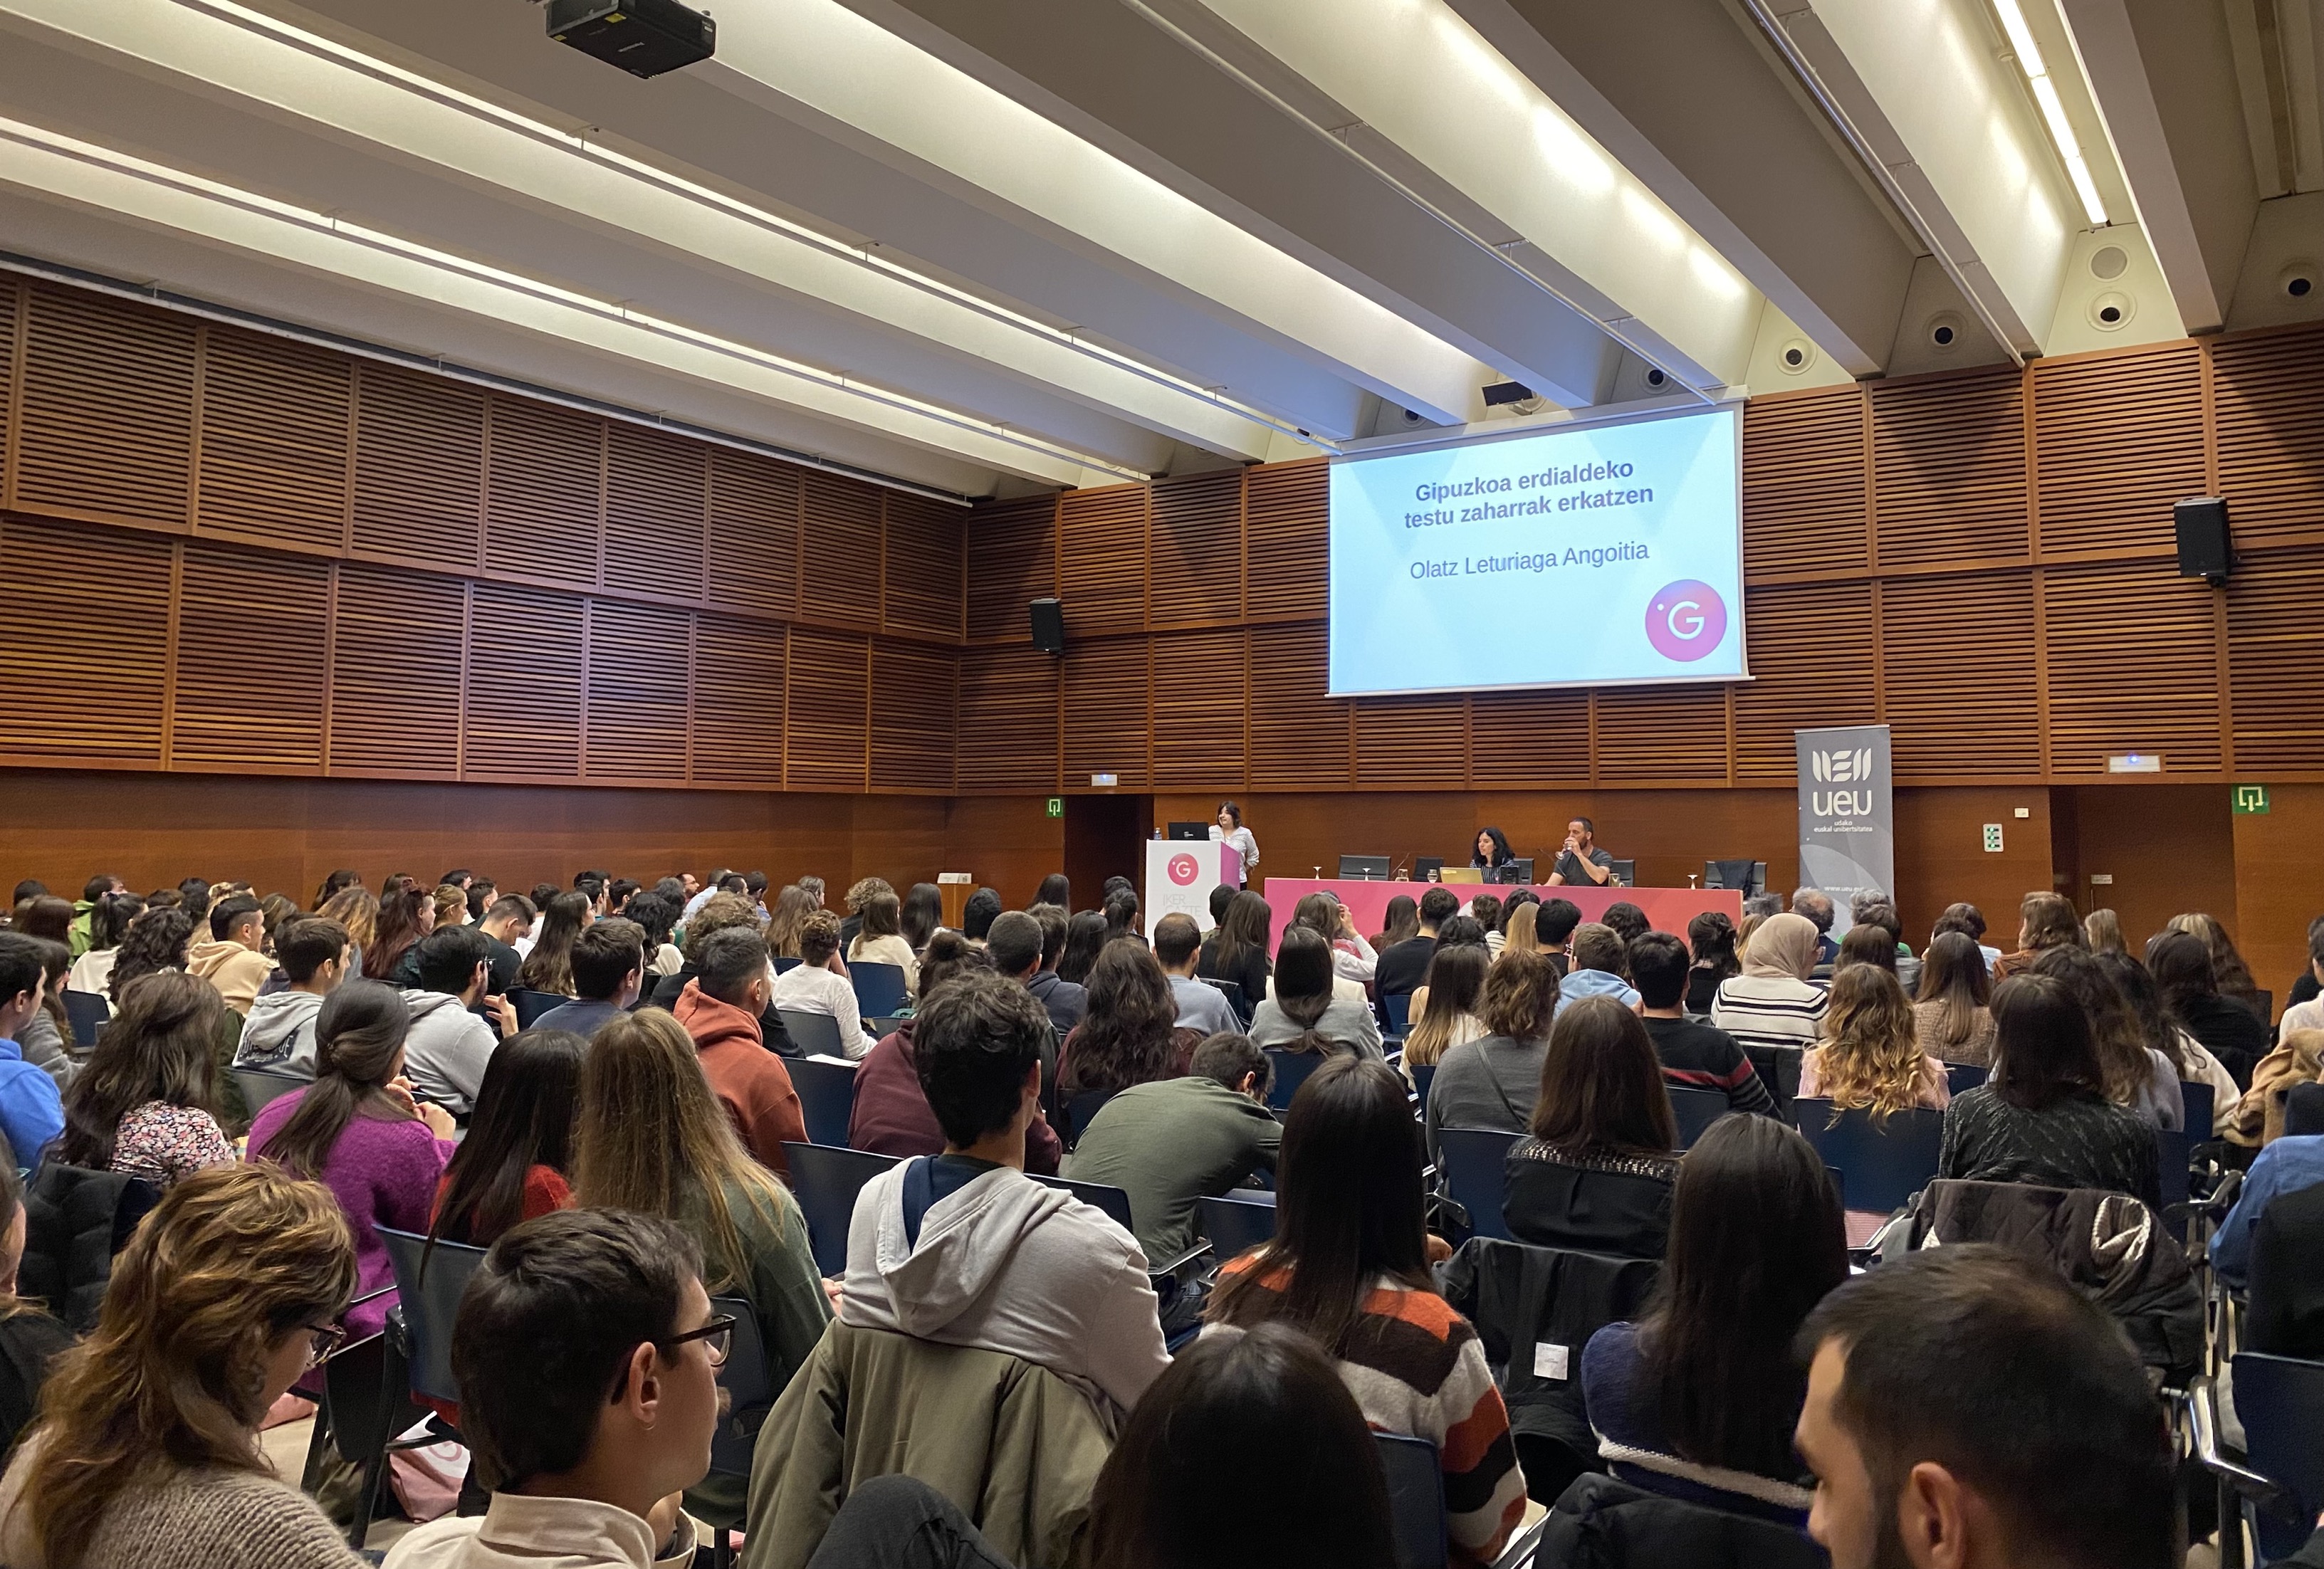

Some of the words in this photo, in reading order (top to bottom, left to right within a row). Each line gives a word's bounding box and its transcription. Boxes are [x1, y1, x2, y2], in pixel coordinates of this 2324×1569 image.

[1415, 476, 1512, 504] Gipuzkoa
[1518, 460, 1633, 490] erdialdeko
[1404, 509, 1454, 529] testu
[1460, 497, 1552, 523] zaharrak
[1558, 486, 1654, 513] erkatzen
[1410, 560, 1458, 579] Olatz
[1465, 547, 1558, 574] Leturiaga
[1562, 541, 1650, 568] Angoitia
[1668, 601, 1705, 640] G
[1176, 861, 1191, 878] G
